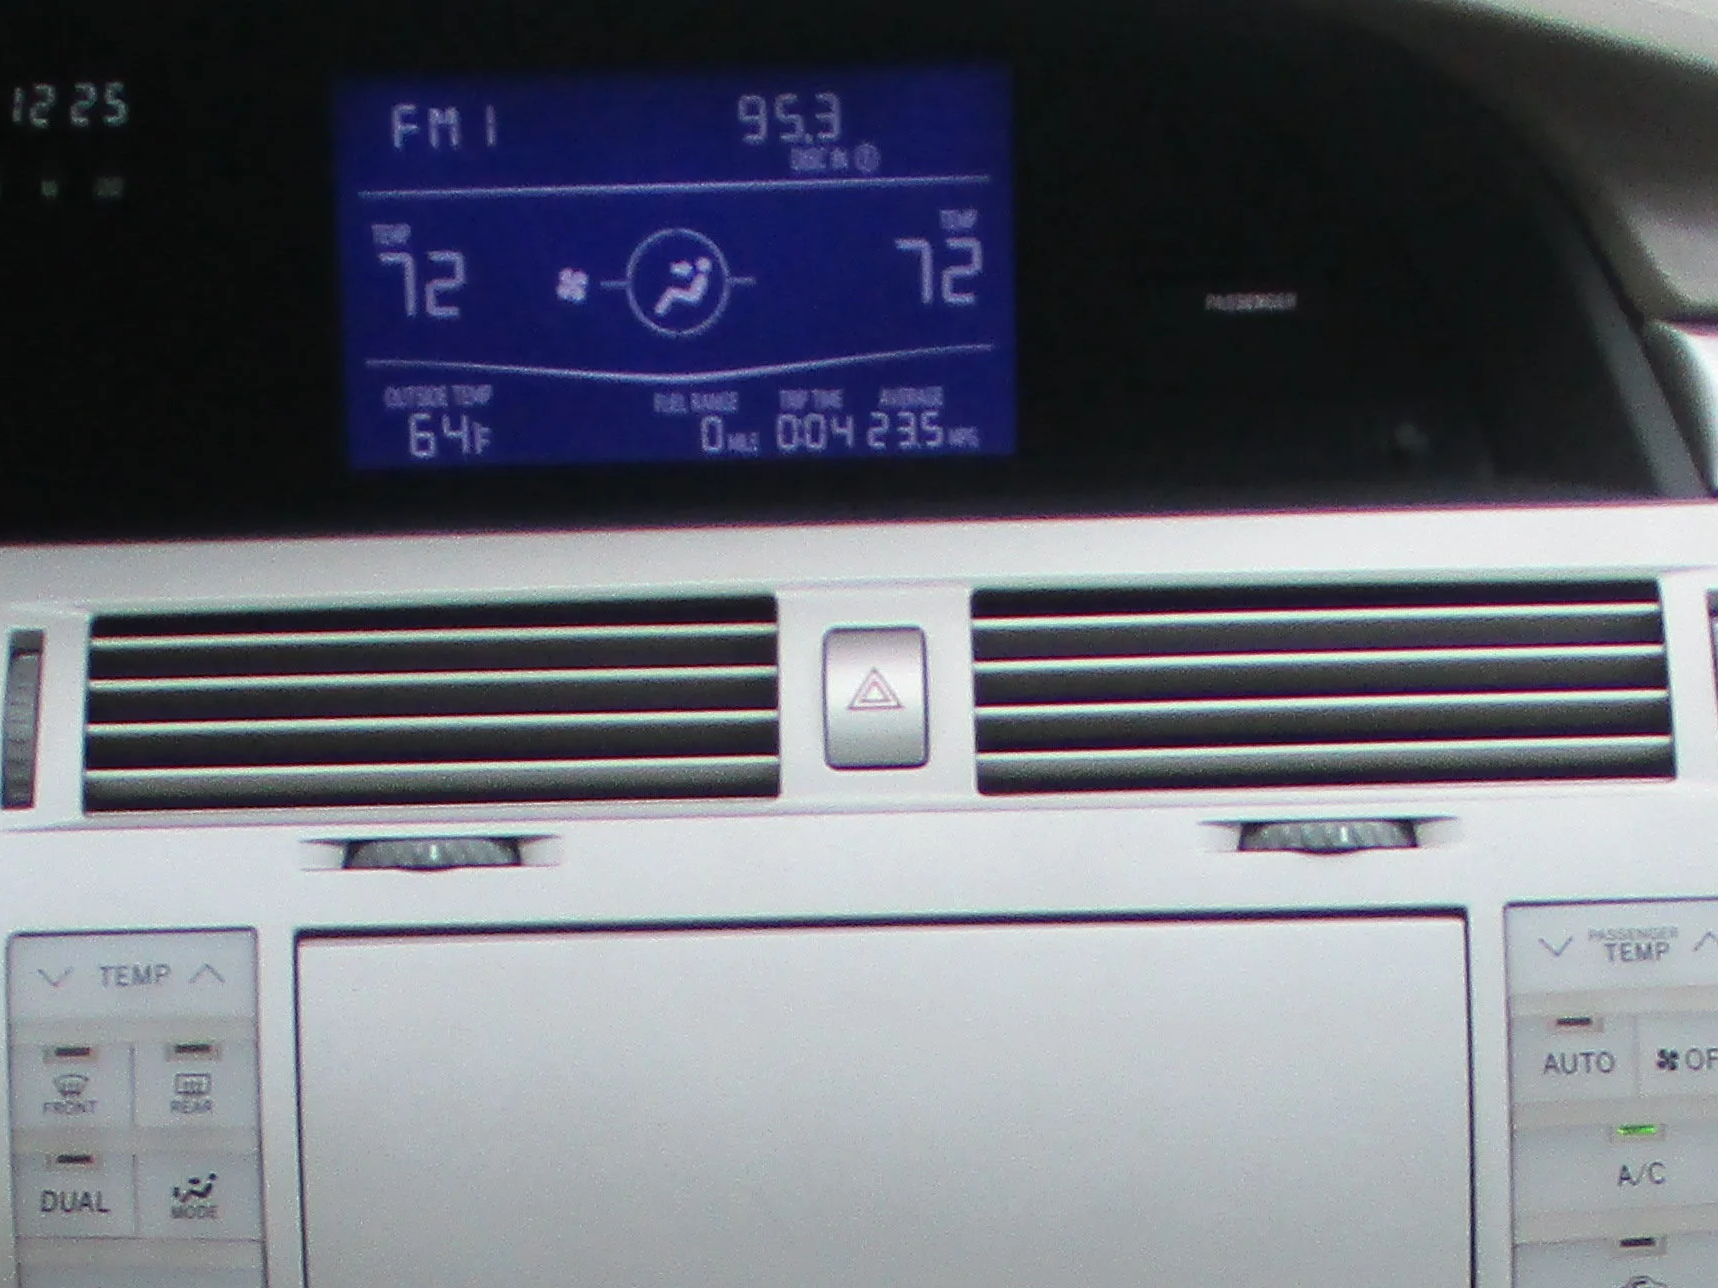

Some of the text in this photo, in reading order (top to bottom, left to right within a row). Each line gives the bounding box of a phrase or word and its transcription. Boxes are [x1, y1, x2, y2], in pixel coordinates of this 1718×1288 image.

[738, 92, 841, 145] 95.3
[895, 237, 984, 305] 72
[378, 250, 467, 321] 72
[1588, 925, 1679, 941] PASSENGER
[1603, 941, 1671, 963] TEMP
[100, 963, 171, 988] TEMP
[1542, 1051, 1616, 1075] AUTO
[42, 1099, 99, 1116] FRONT
[169, 1099, 214, 1115] REAR
[1616, 1161, 1667, 1186] A/C
[40, 1189, 112, 1214] DUAL
[170, 1204, 219, 1220] MODE
